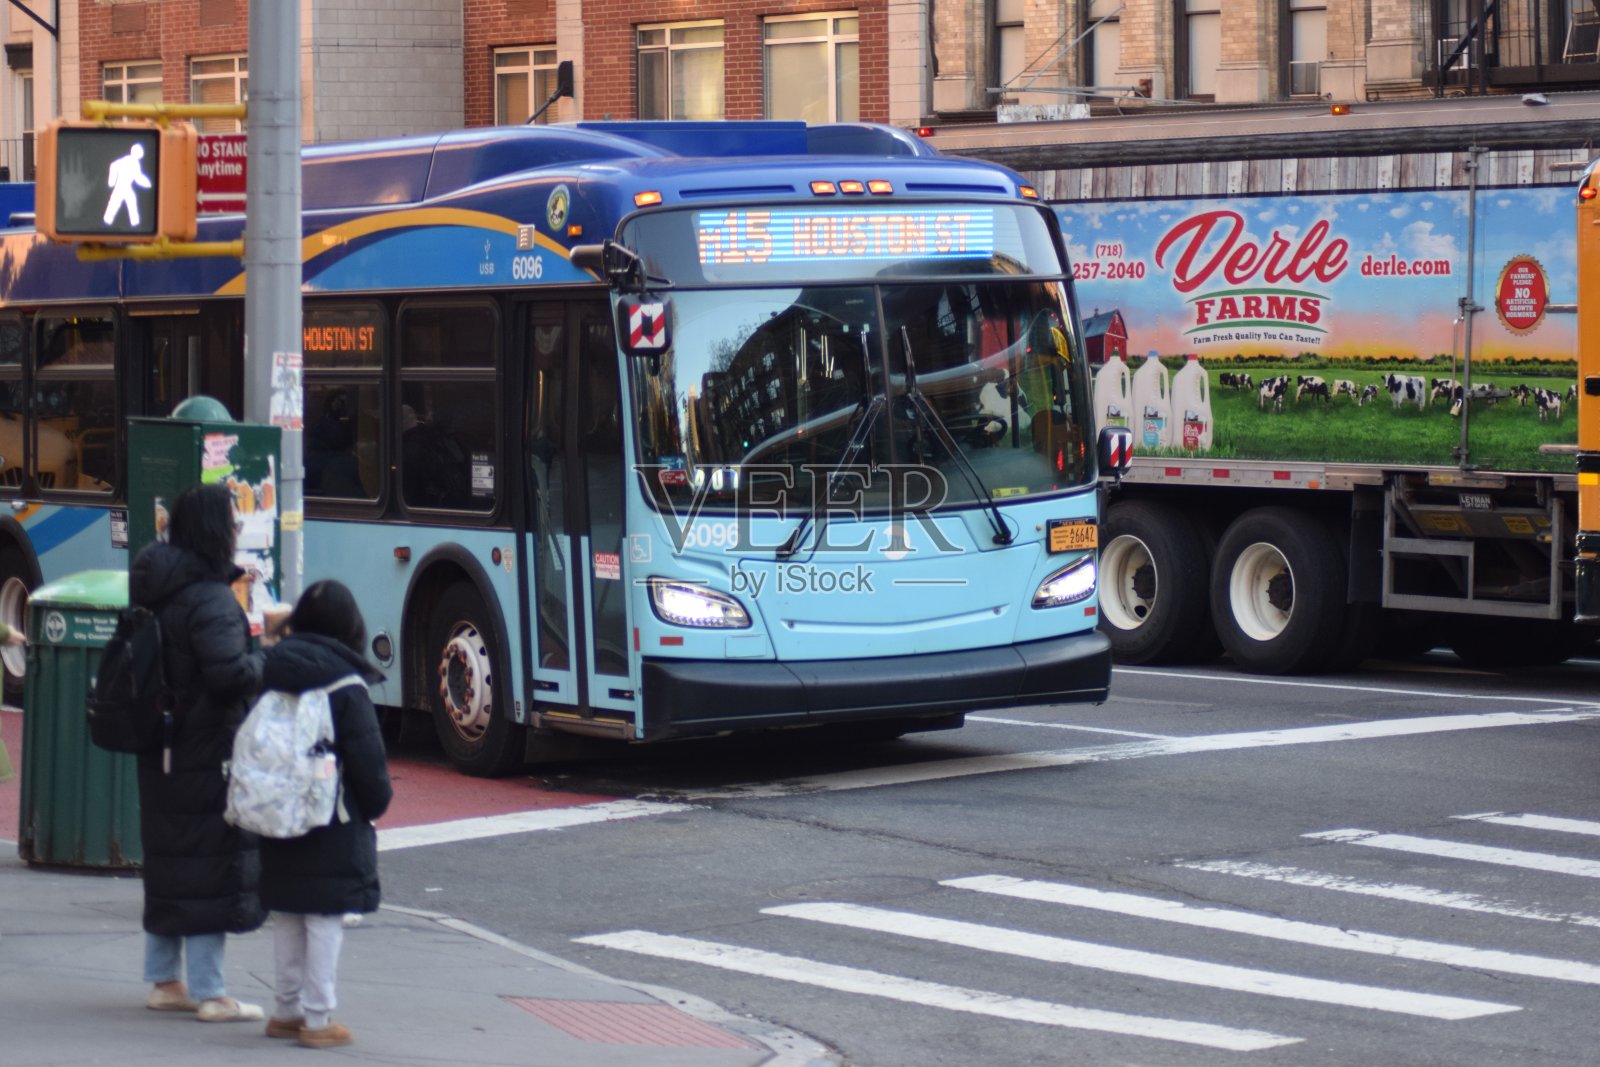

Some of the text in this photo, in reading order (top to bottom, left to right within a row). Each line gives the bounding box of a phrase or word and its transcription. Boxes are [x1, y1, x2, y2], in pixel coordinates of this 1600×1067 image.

[212, 142, 248, 157] STAND
[793, 215, 926, 255] HOUSTON
[936, 215, 971, 254] ST
[1095, 243, 1123, 260] (718)
[1155, 210, 1349, 293] Derle
[479, 262, 495, 275] USB
[512, 255, 543, 280] 6096
[1072, 261, 1146, 280] 257-2040
[1360, 254, 1451, 276] derle.com
[1515, 287, 1530, 298] NO
[1195, 295, 1321, 325] FARMS
[303, 326, 375, 352] HOUSTON ST
[1193, 336, 1211, 345] Farm
[1213, 333, 1233, 342] Fresh
[1235, 332, 1262, 341] Quality
[1263, 332, 1277, 340] You
[1279, 333, 1293, 341] Can
[1460, 495, 1491, 505] LEYMAN
[683, 522, 739, 548] 6096
[595, 553, 619, 565] CAUTION
